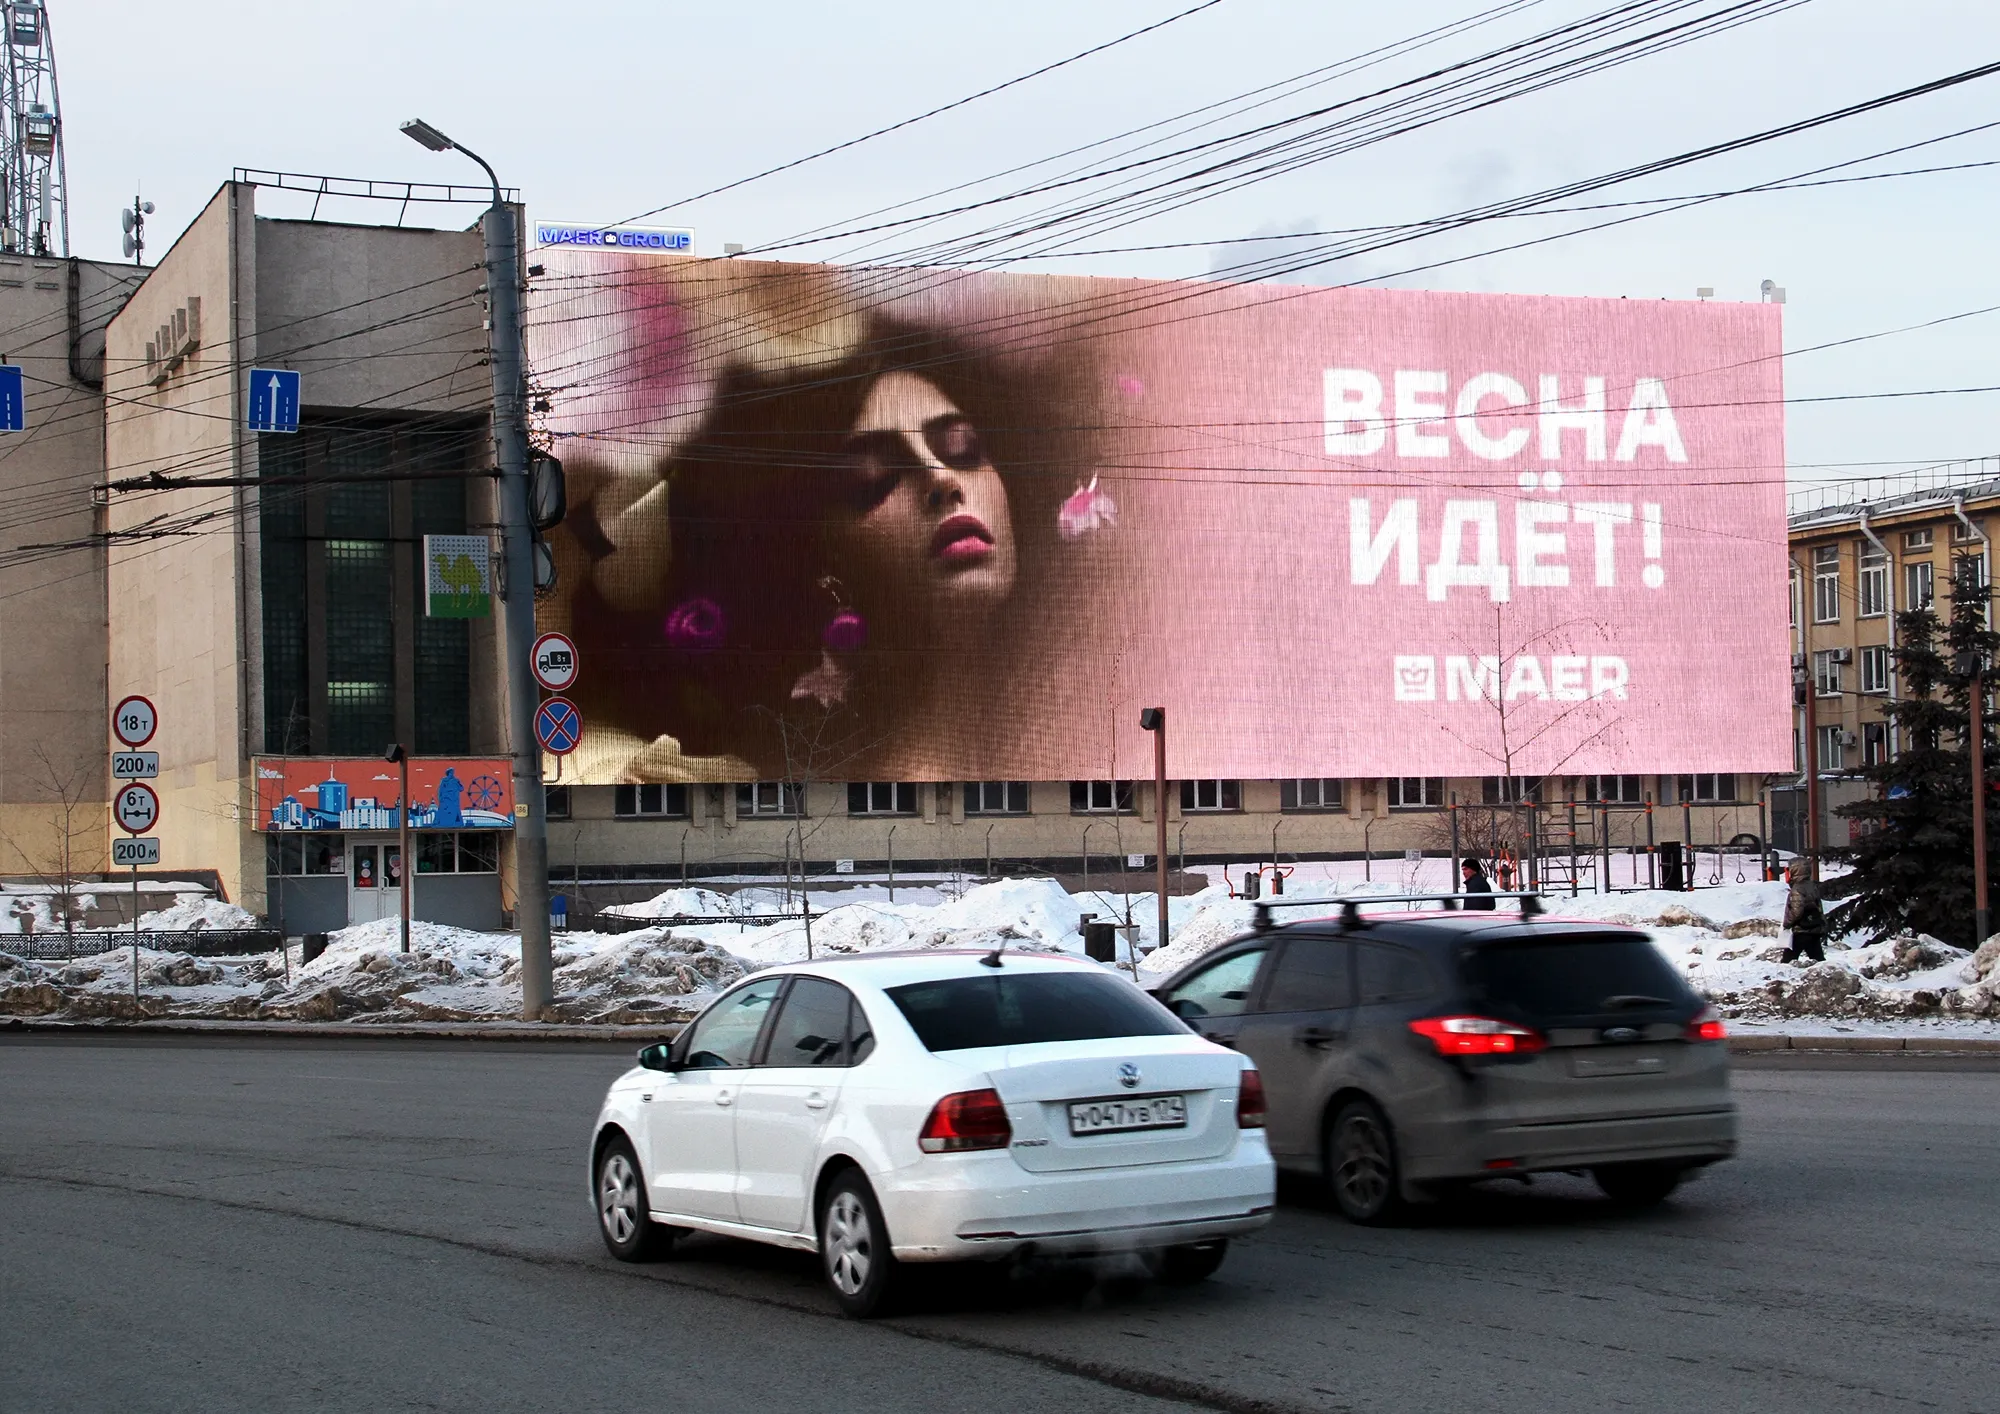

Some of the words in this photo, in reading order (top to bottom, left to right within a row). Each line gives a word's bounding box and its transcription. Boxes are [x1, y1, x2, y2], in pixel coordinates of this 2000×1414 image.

[538, 227, 602, 245] MAER
[619, 231, 692, 249] GROUP
[1323, 367, 1689, 463] ВЕСНА
[1349, 470, 1665, 603] ИДЁТ!
[1445, 655, 1630, 701] MAER
[116, 757, 144, 773] 200
[117, 844, 146, 860] 200
